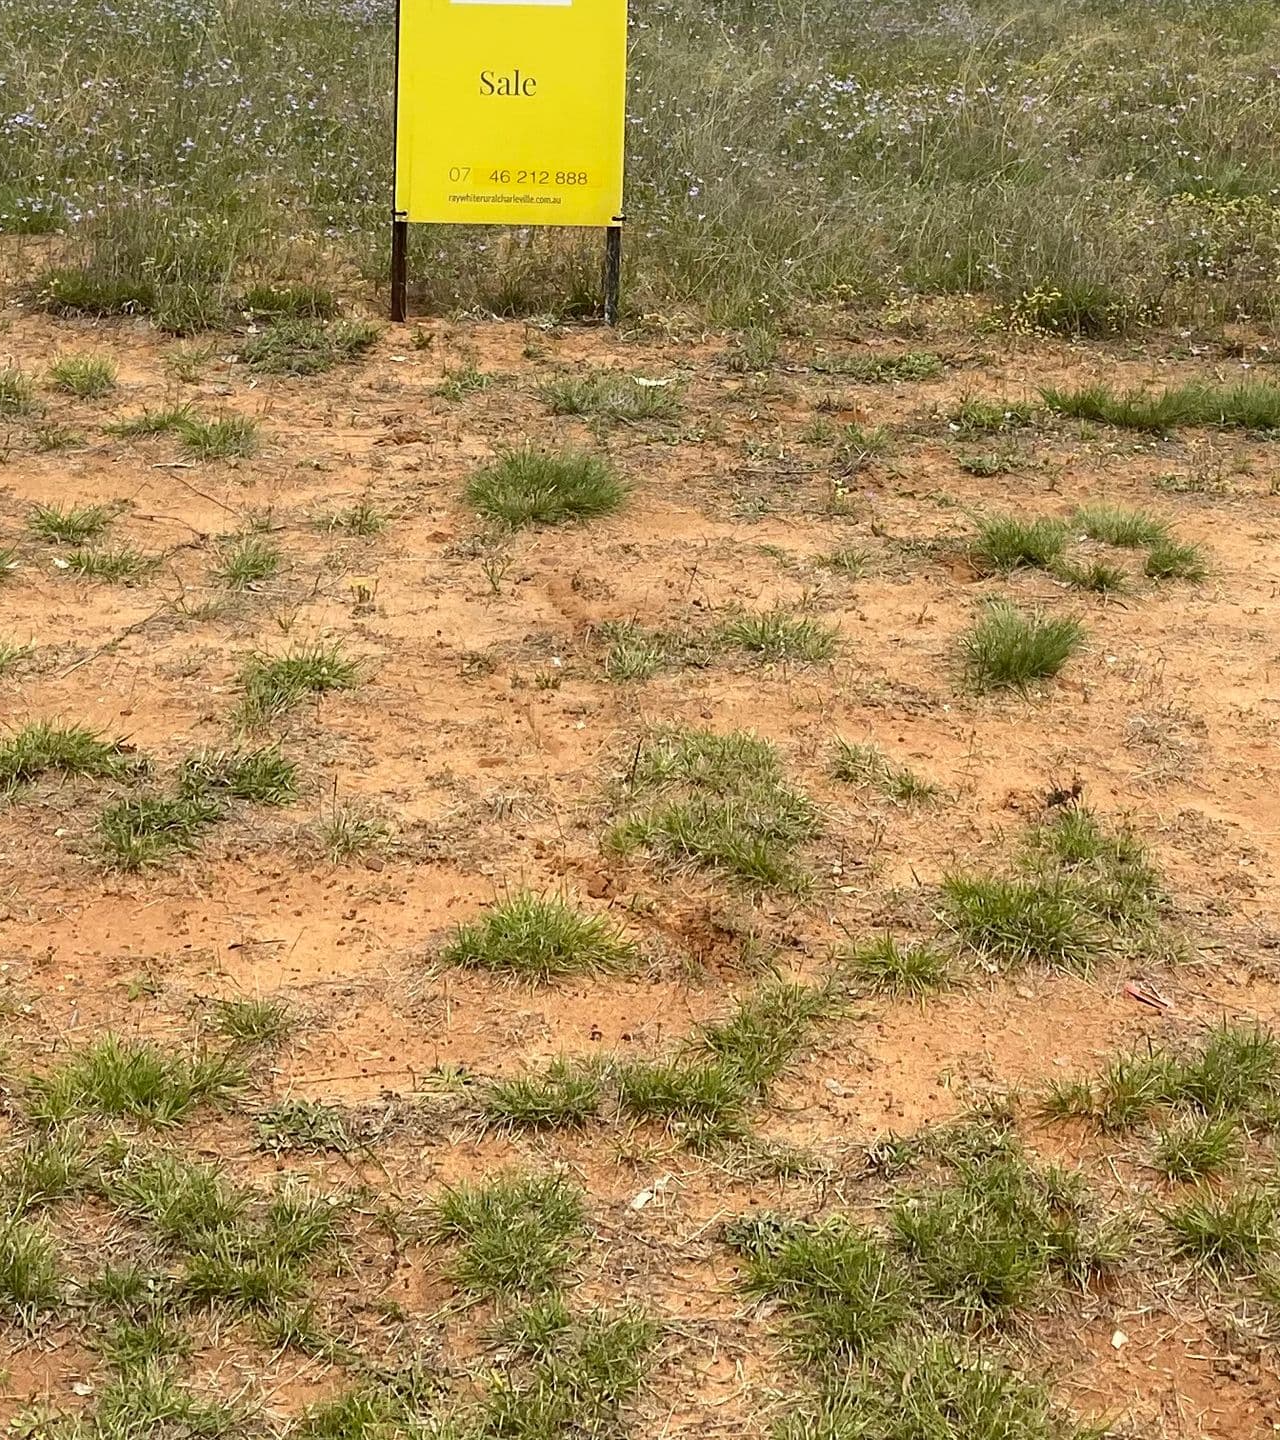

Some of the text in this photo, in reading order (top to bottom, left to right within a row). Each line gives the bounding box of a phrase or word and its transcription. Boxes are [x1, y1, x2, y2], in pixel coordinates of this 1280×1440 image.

[479, 69, 537, 97] Sale
[449, 167, 588, 185] 07 46 212 888
[448, 193, 562, 205] raywhiteruralcharleville.com.au
